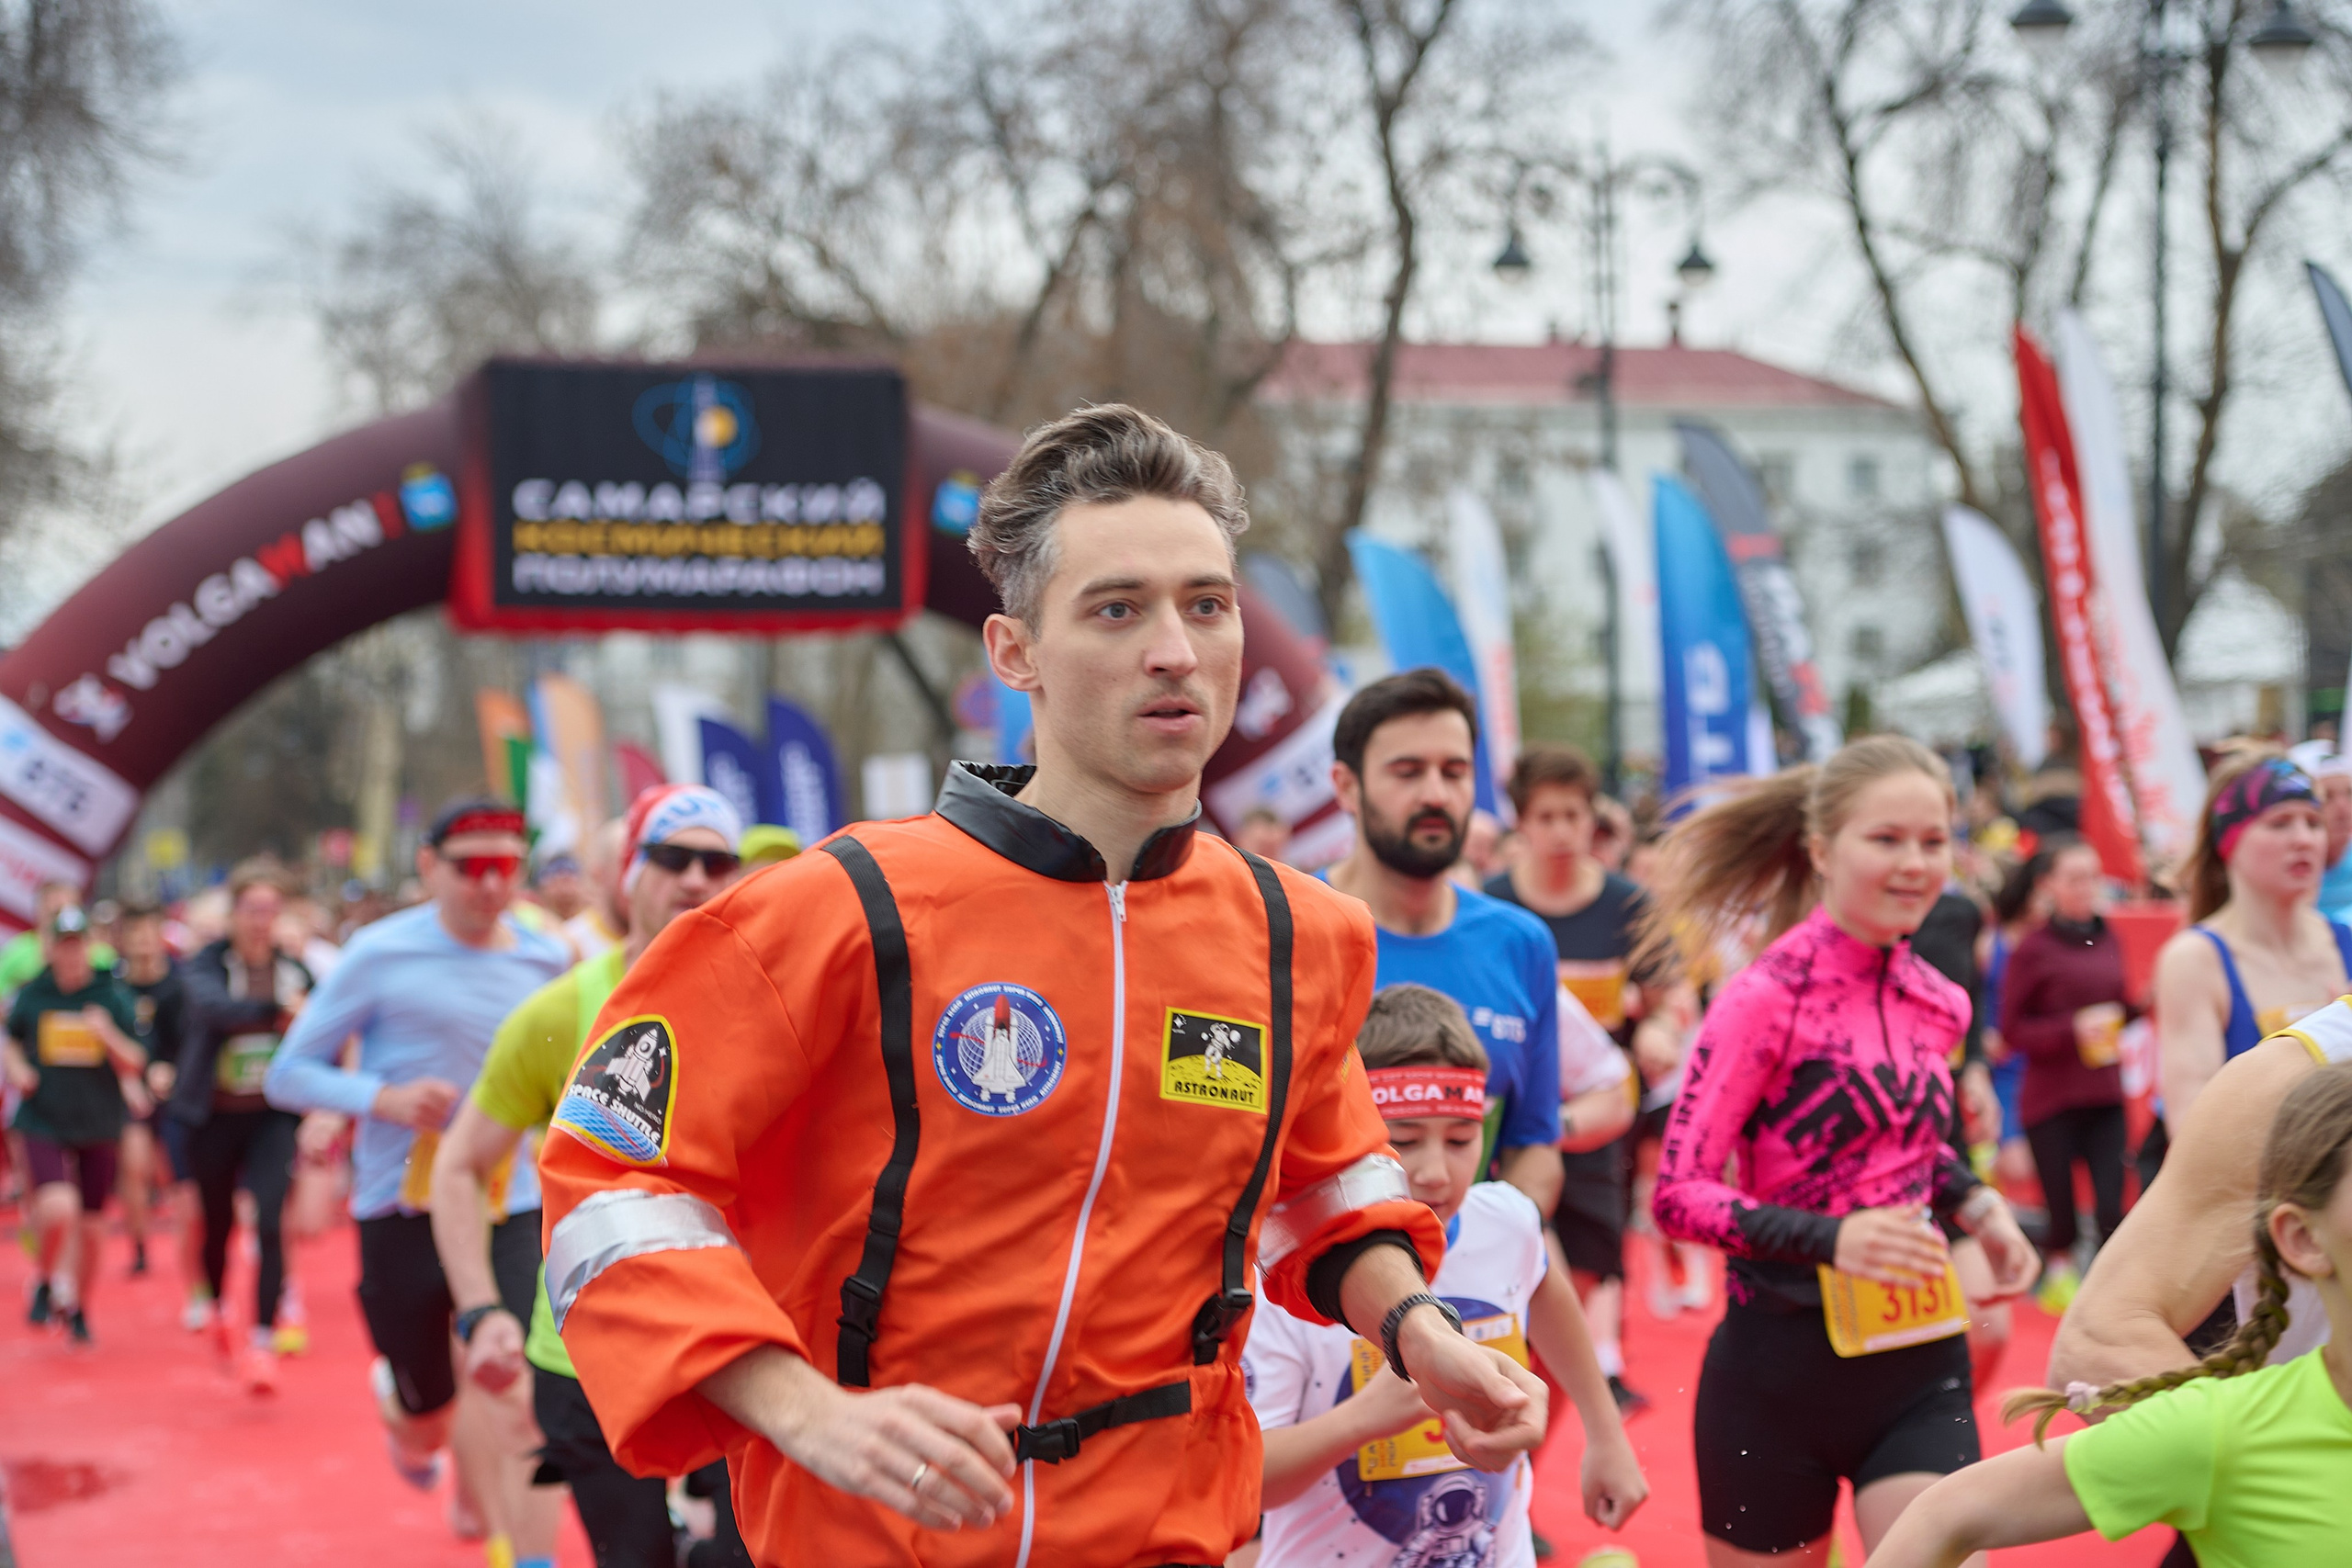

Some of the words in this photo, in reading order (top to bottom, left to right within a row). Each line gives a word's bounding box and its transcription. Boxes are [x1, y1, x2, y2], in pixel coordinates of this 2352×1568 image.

[512, 477, 887, 522] САМАРСКИЙ
[568, 1083, 610, 1106] SPACE
[609, 1099, 661, 1144] SHUTTLE
[1174, 1081, 1254, 1104] ASTRONAUT
